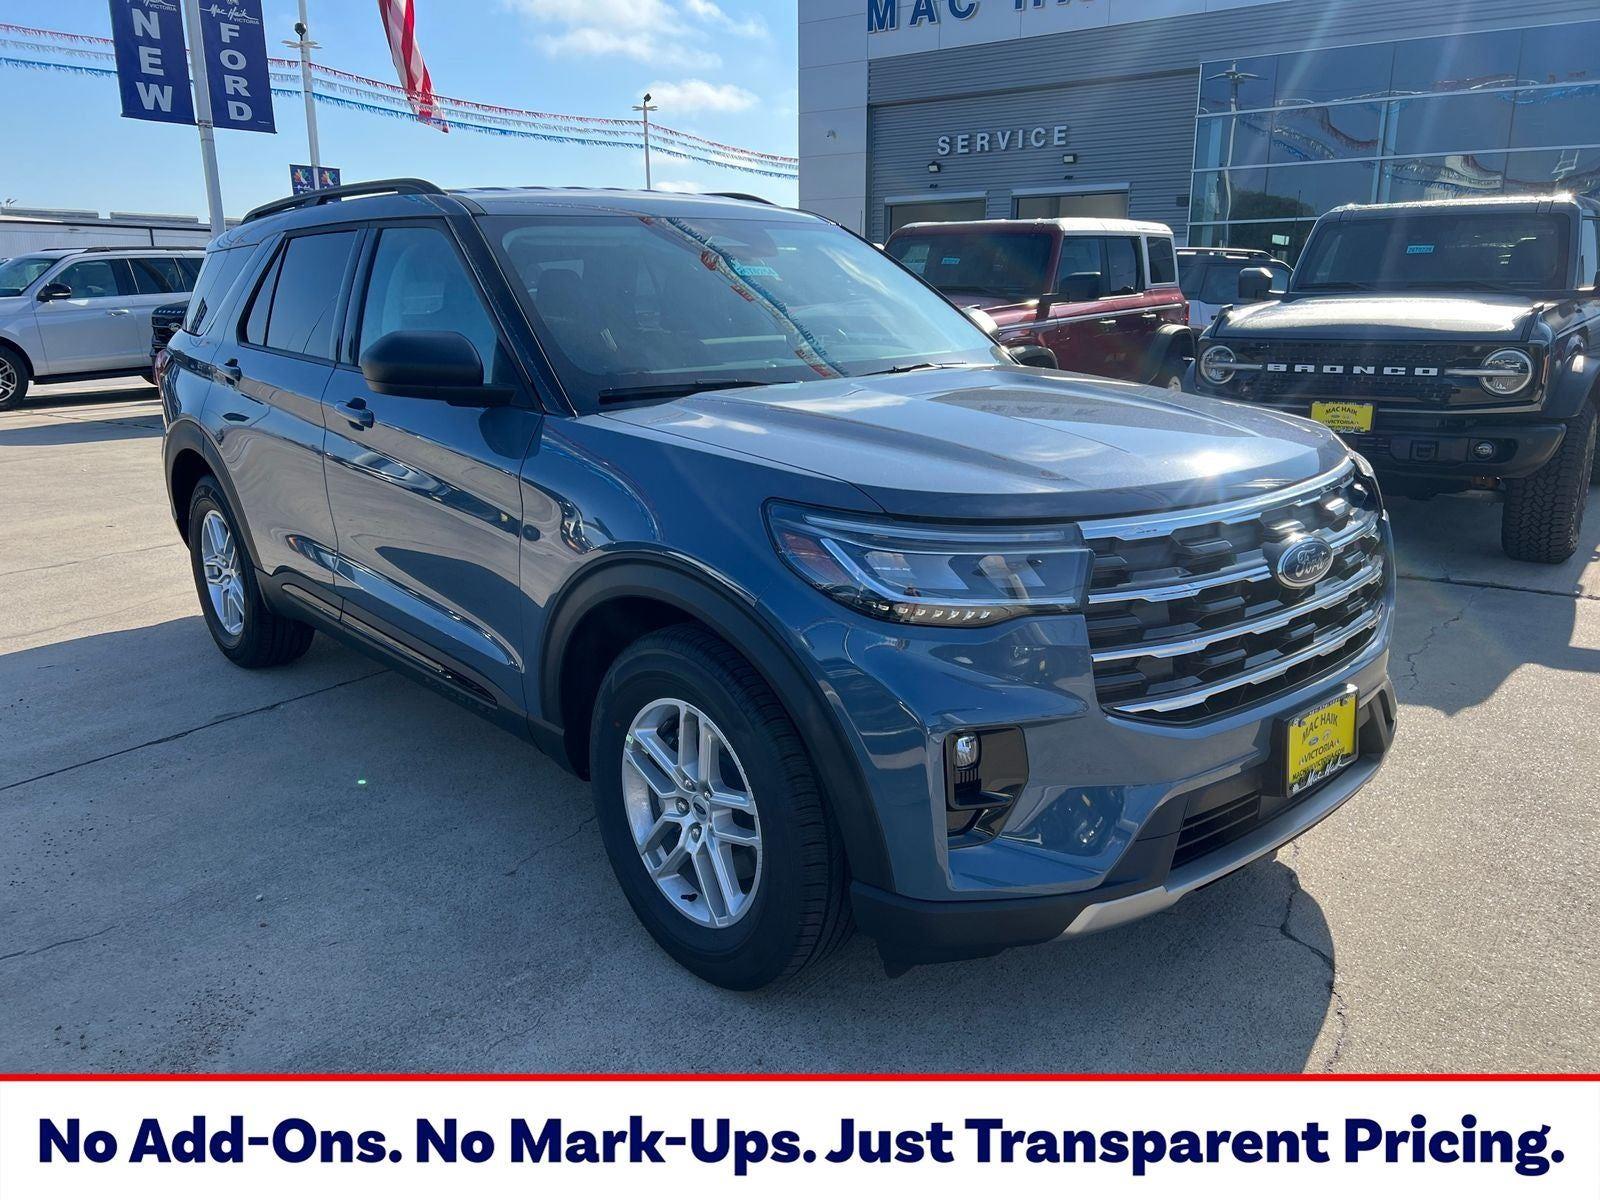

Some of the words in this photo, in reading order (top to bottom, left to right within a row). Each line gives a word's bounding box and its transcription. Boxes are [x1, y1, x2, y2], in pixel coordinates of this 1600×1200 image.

[867, 0, 977, 33] MAC
[131, 7, 173, 113] NEW
[219, 22, 253, 122] FORD
[938, 125, 1069, 155] SERVICE
[1267, 363, 1438, 376] BRONCO
[1302, 717, 1319, 744] MAC
[1320, 712, 1338, 726] HAIK
[1303, 740, 1336, 763] VICTORIA
